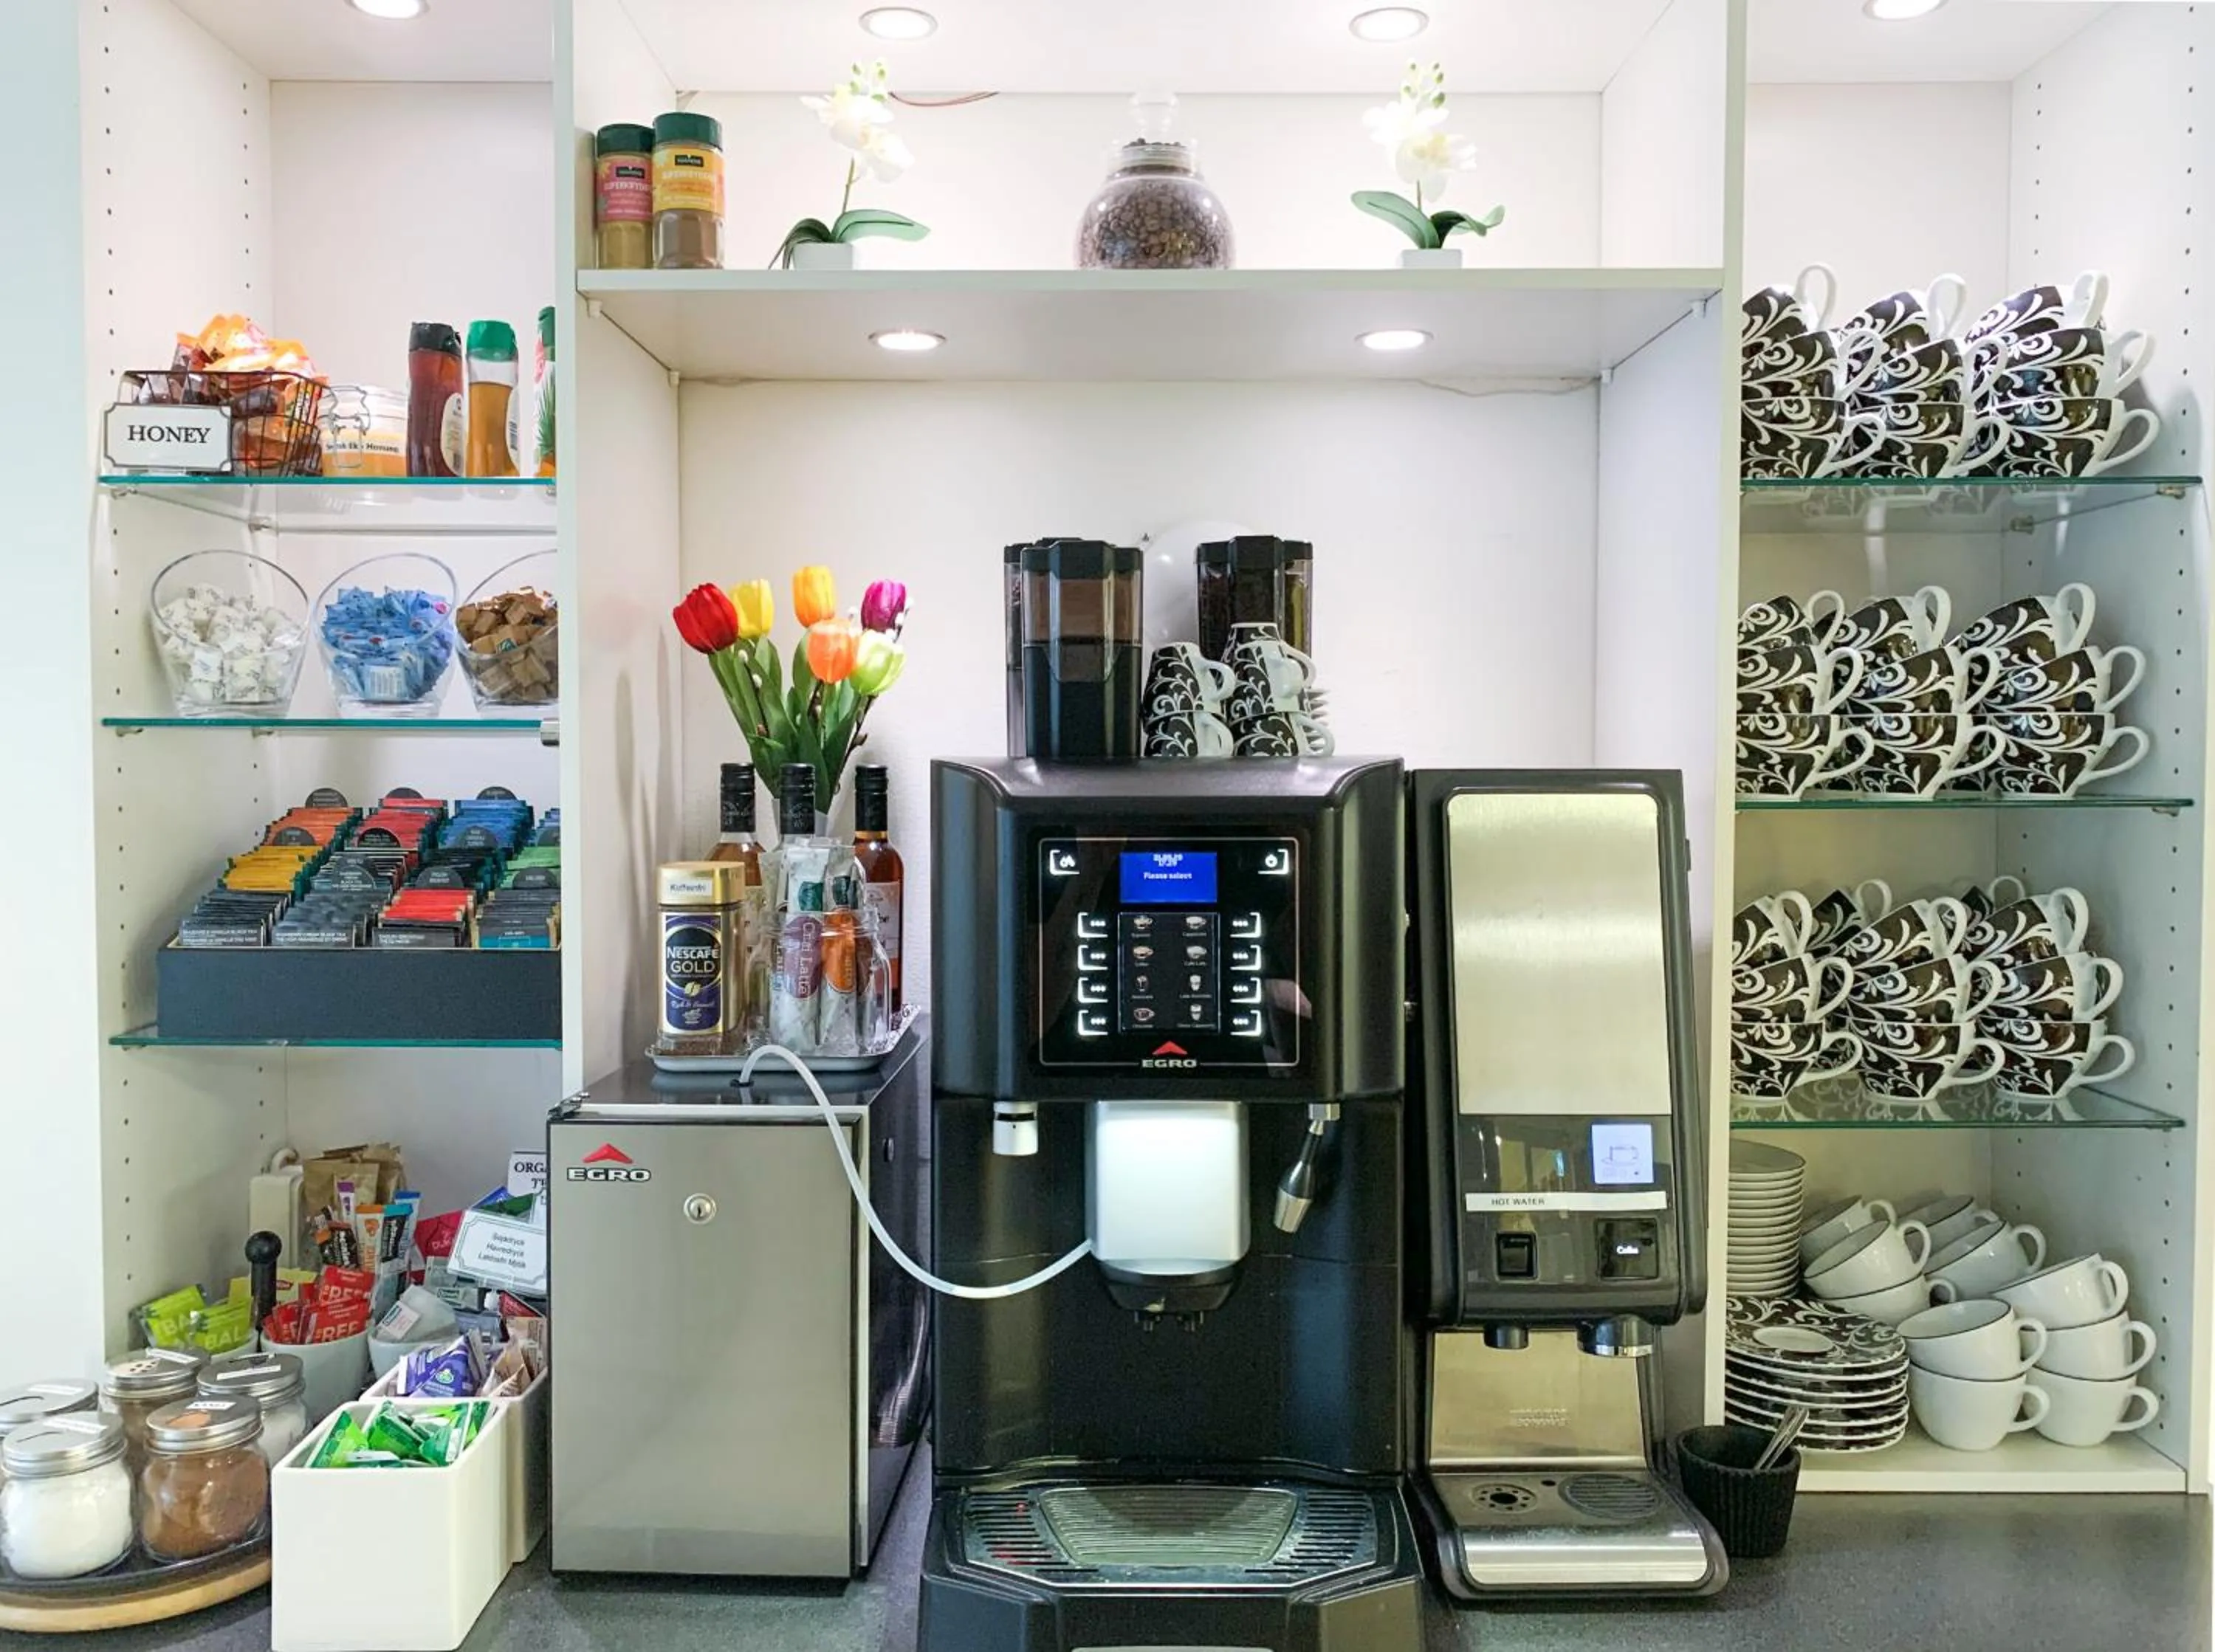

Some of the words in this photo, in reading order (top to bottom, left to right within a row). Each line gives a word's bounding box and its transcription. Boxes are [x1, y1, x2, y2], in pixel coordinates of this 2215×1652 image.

[127, 424, 211, 444] HONEY
[670, 960, 715, 974] GOLD
[798, 956, 813, 994] Latte
[1141, 1059, 1198, 1068] EGRO
[514, 1162, 547, 1173] ORG
[567, 1168, 651, 1182] EGRO
